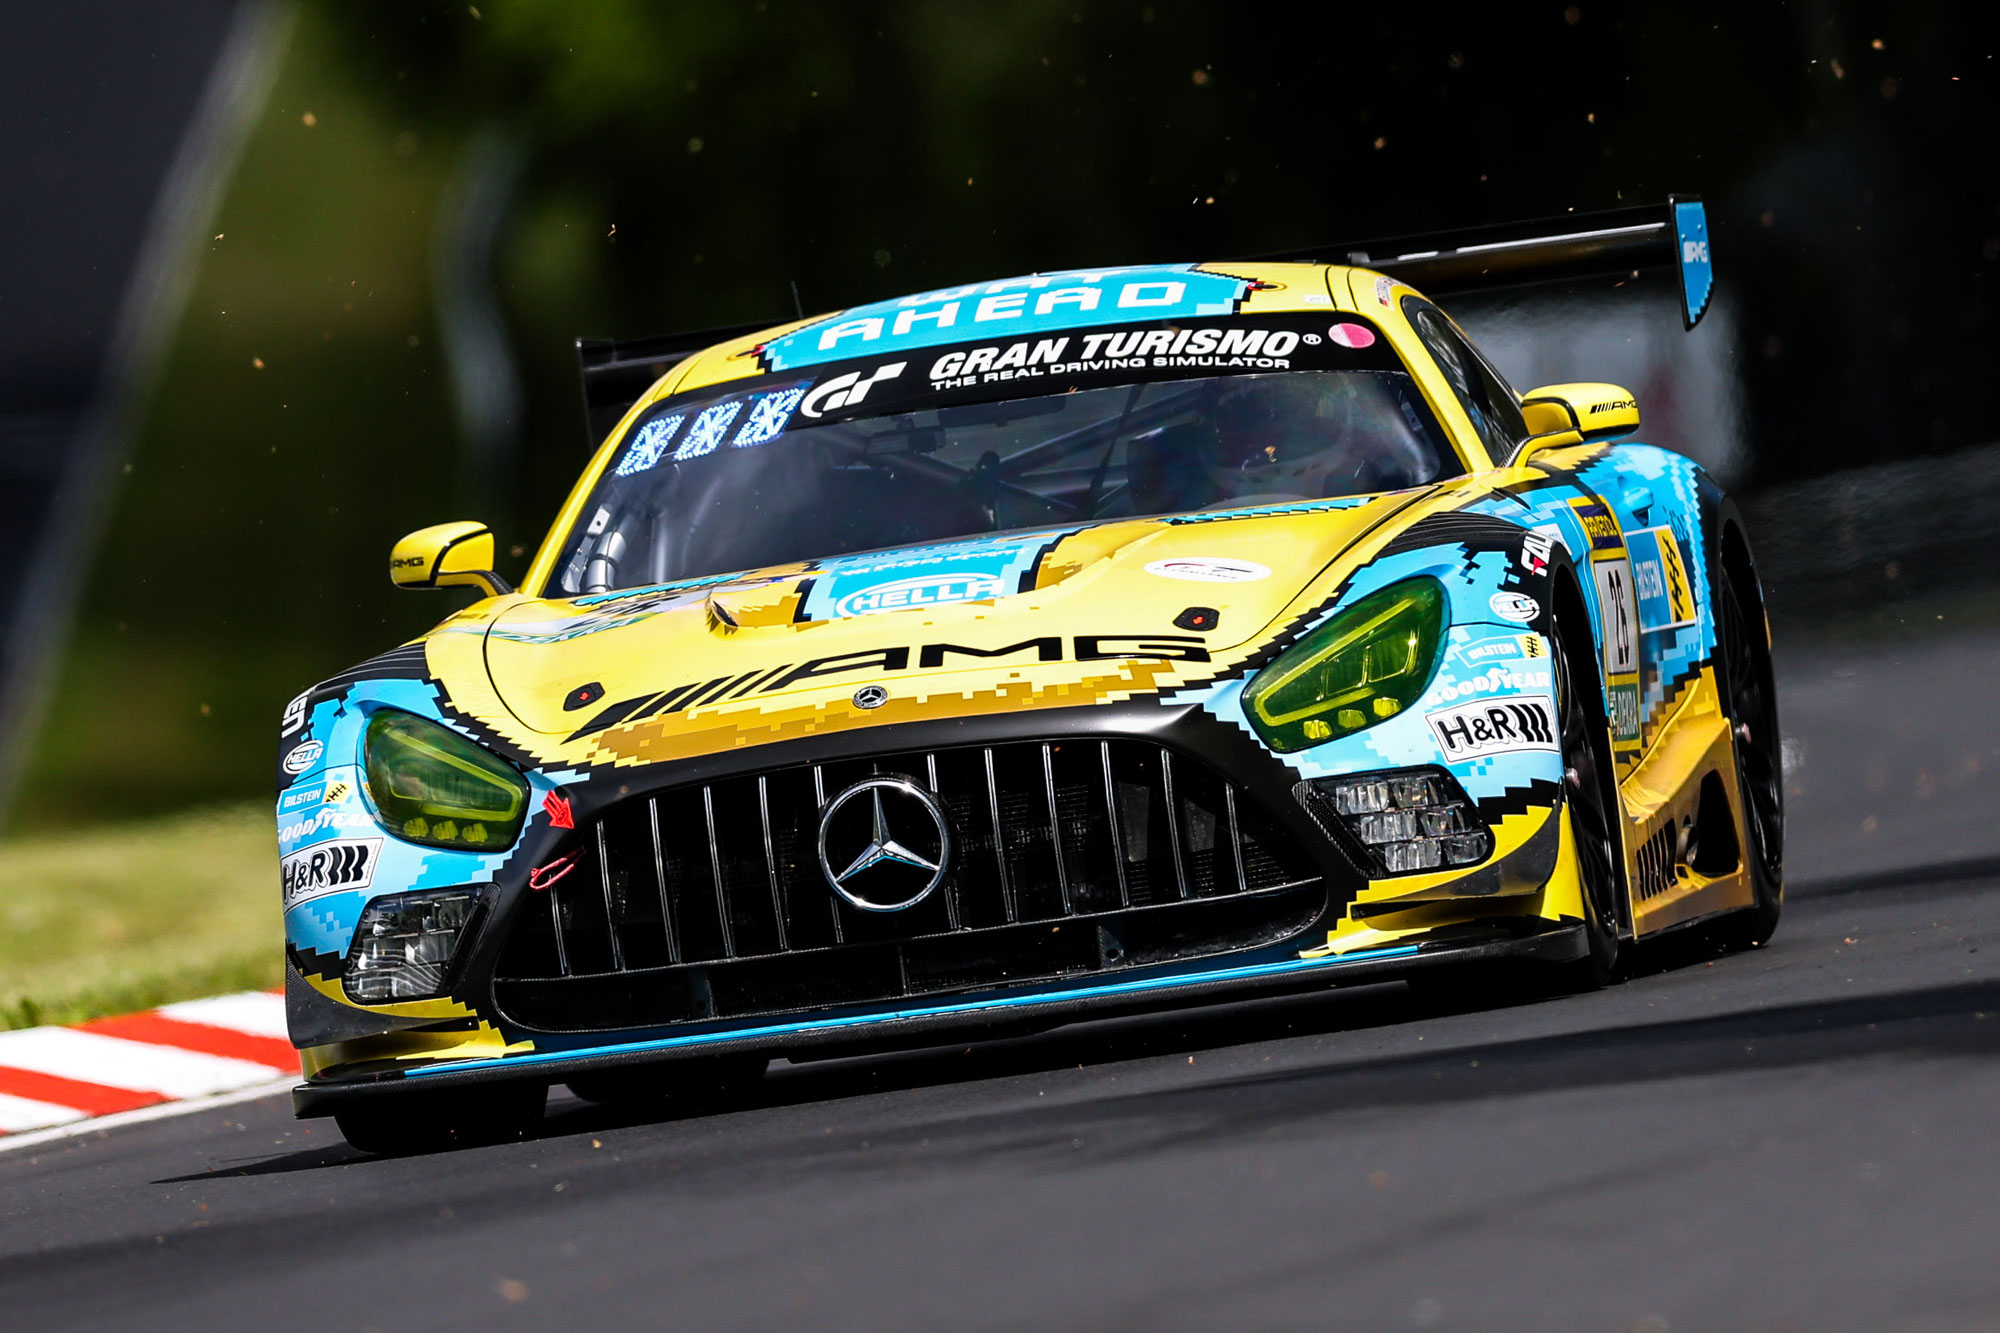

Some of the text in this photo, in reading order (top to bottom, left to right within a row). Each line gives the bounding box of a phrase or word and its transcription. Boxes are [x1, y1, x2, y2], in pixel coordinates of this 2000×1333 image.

[818, 281, 1186, 350] AHEAD
[929, 337, 1070, 380] GRAN
[931, 356, 1290, 391] THE REAL DRIVING SIMULATOR
[1521, 533, 1554, 577] FAL
[853, 579, 1005, 611] HELLA
[1494, 599, 1540, 613] HELLA
[758, 635, 1211, 693] AMG
[1468, 643, 1517, 660] BILSTEIN
[1427, 667, 1550, 706] GOODYEAR
[1437, 708, 1517, 749] H&R
[287, 747, 324, 765] HELLA
[283, 788, 322, 808] BILSTEIN
[283, 852, 326, 902] H&R
